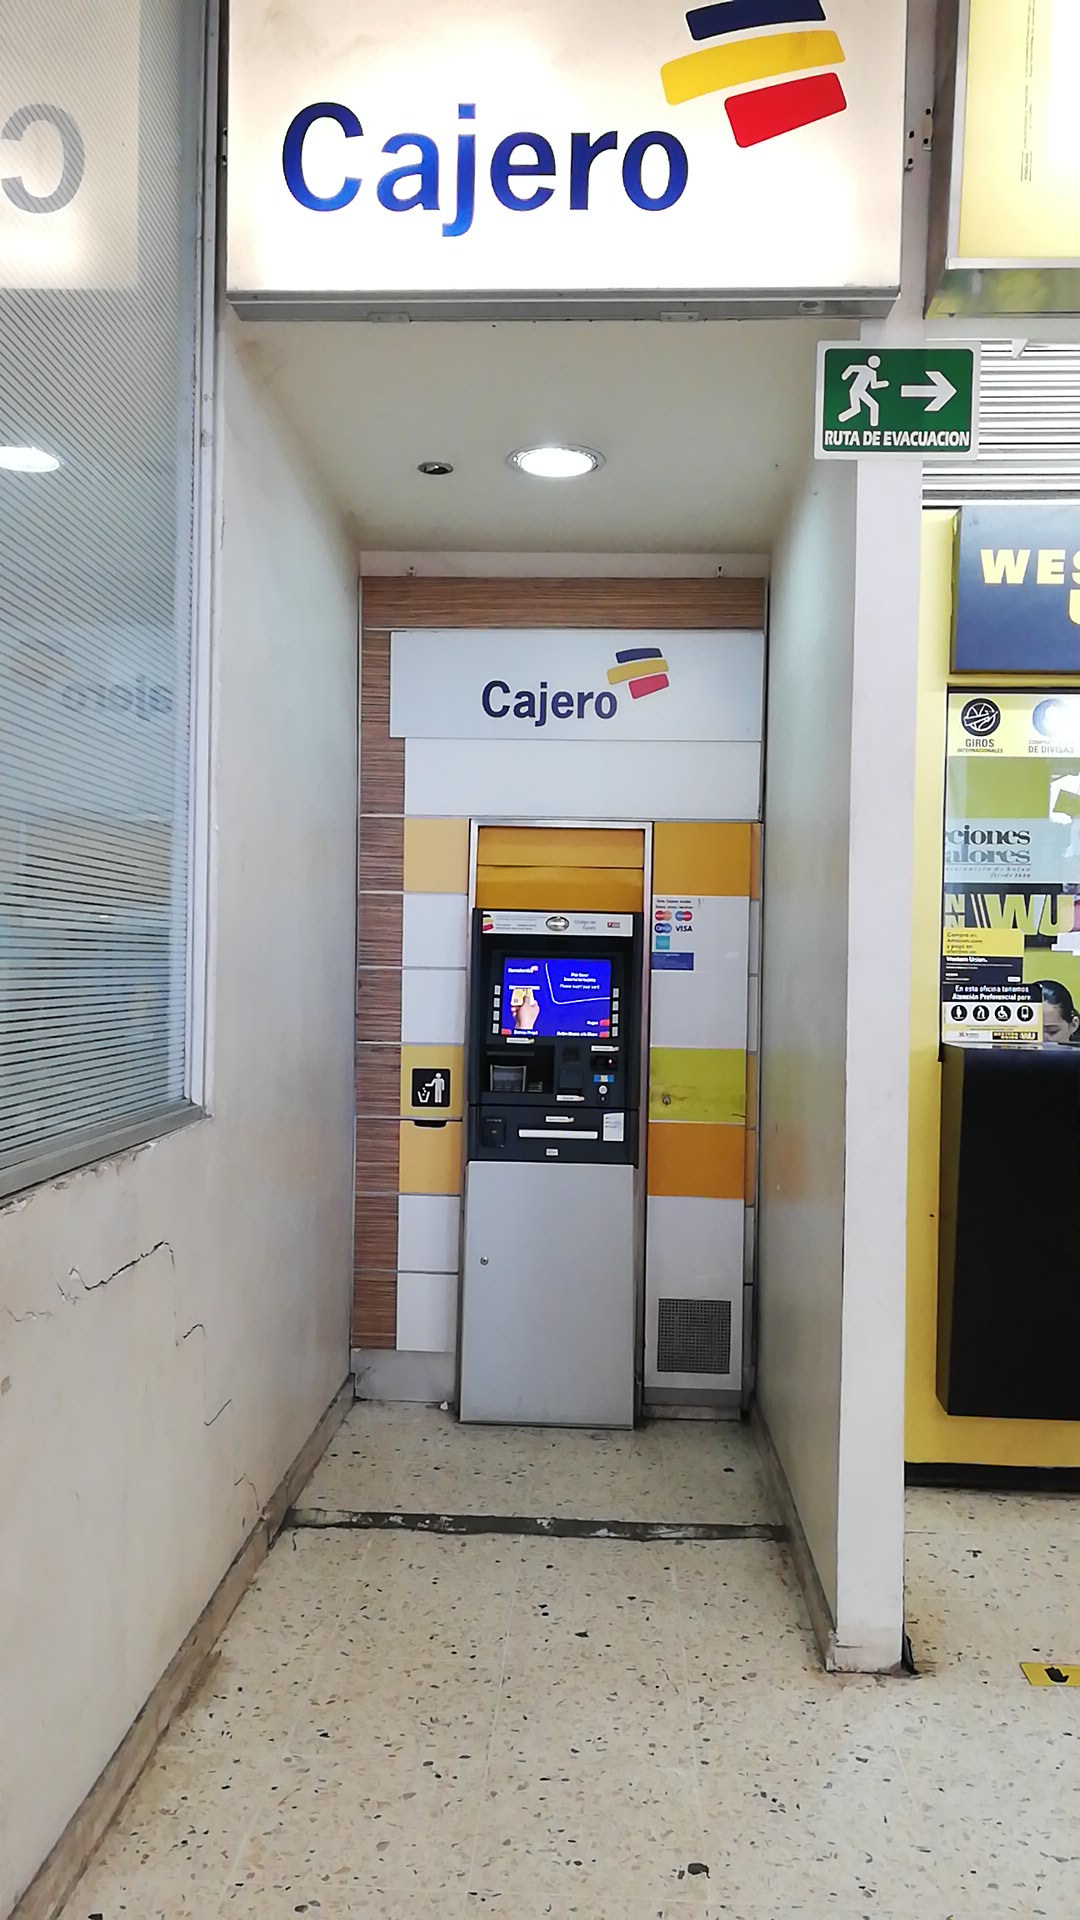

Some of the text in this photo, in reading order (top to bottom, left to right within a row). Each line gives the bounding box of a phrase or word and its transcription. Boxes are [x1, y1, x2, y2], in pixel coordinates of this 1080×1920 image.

[282, 102, 689, 237] Cajero
[824, 430, 970, 447] RUTA DE EVACUACION
[980, 548, 1080, 585] WE
[482, 680, 618, 727] Cajero
[965, 738, 995, 748] GIROS
[1028, 745, 1075, 754] DE DIVISAS
[945, 824, 1031, 846] ciones
[955, 985, 1029, 993] En esta oficina tenemos
[980, 993, 1016, 1001] Preferencial
